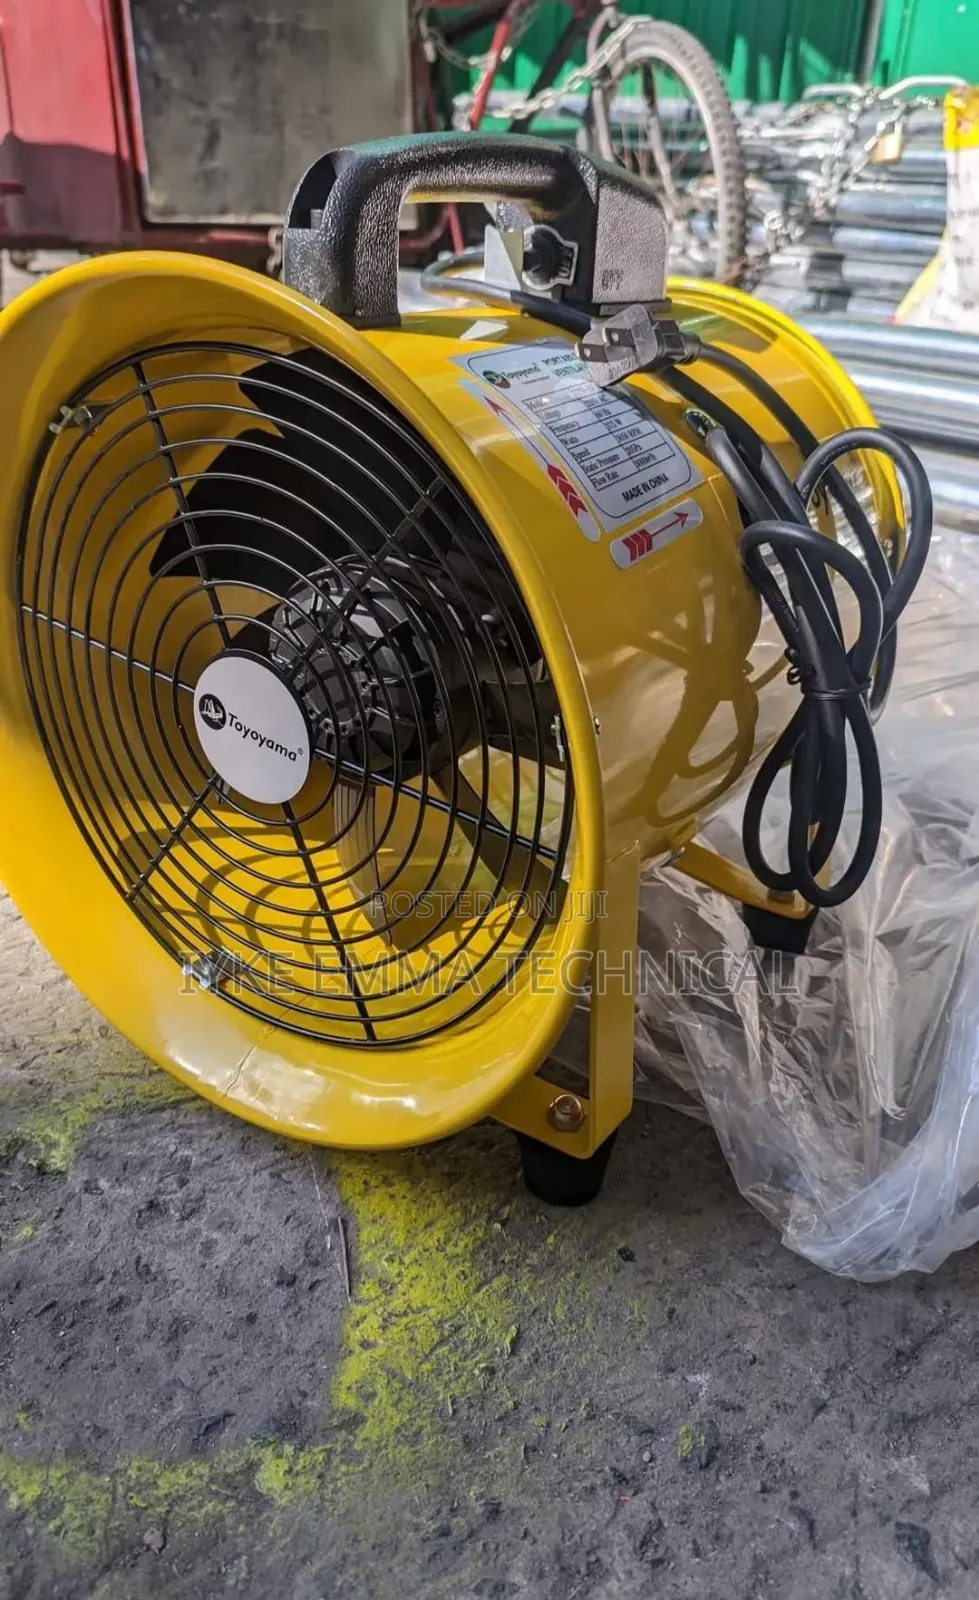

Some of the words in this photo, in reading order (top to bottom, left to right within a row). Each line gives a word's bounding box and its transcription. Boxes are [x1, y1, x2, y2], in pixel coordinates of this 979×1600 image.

[549, 421, 580, 434] Frequency
[571, 447, 591, 462] Speed
[581, 460, 599, 474] Static
[596, 454, 620, 467] Pressure
[589, 475, 607, 487] Flow
[604, 471, 620, 481] Rate
[621, 485, 643, 502] MADE
[640, 481, 651, 493] IN
[649, 473, 670, 489] CHINA
